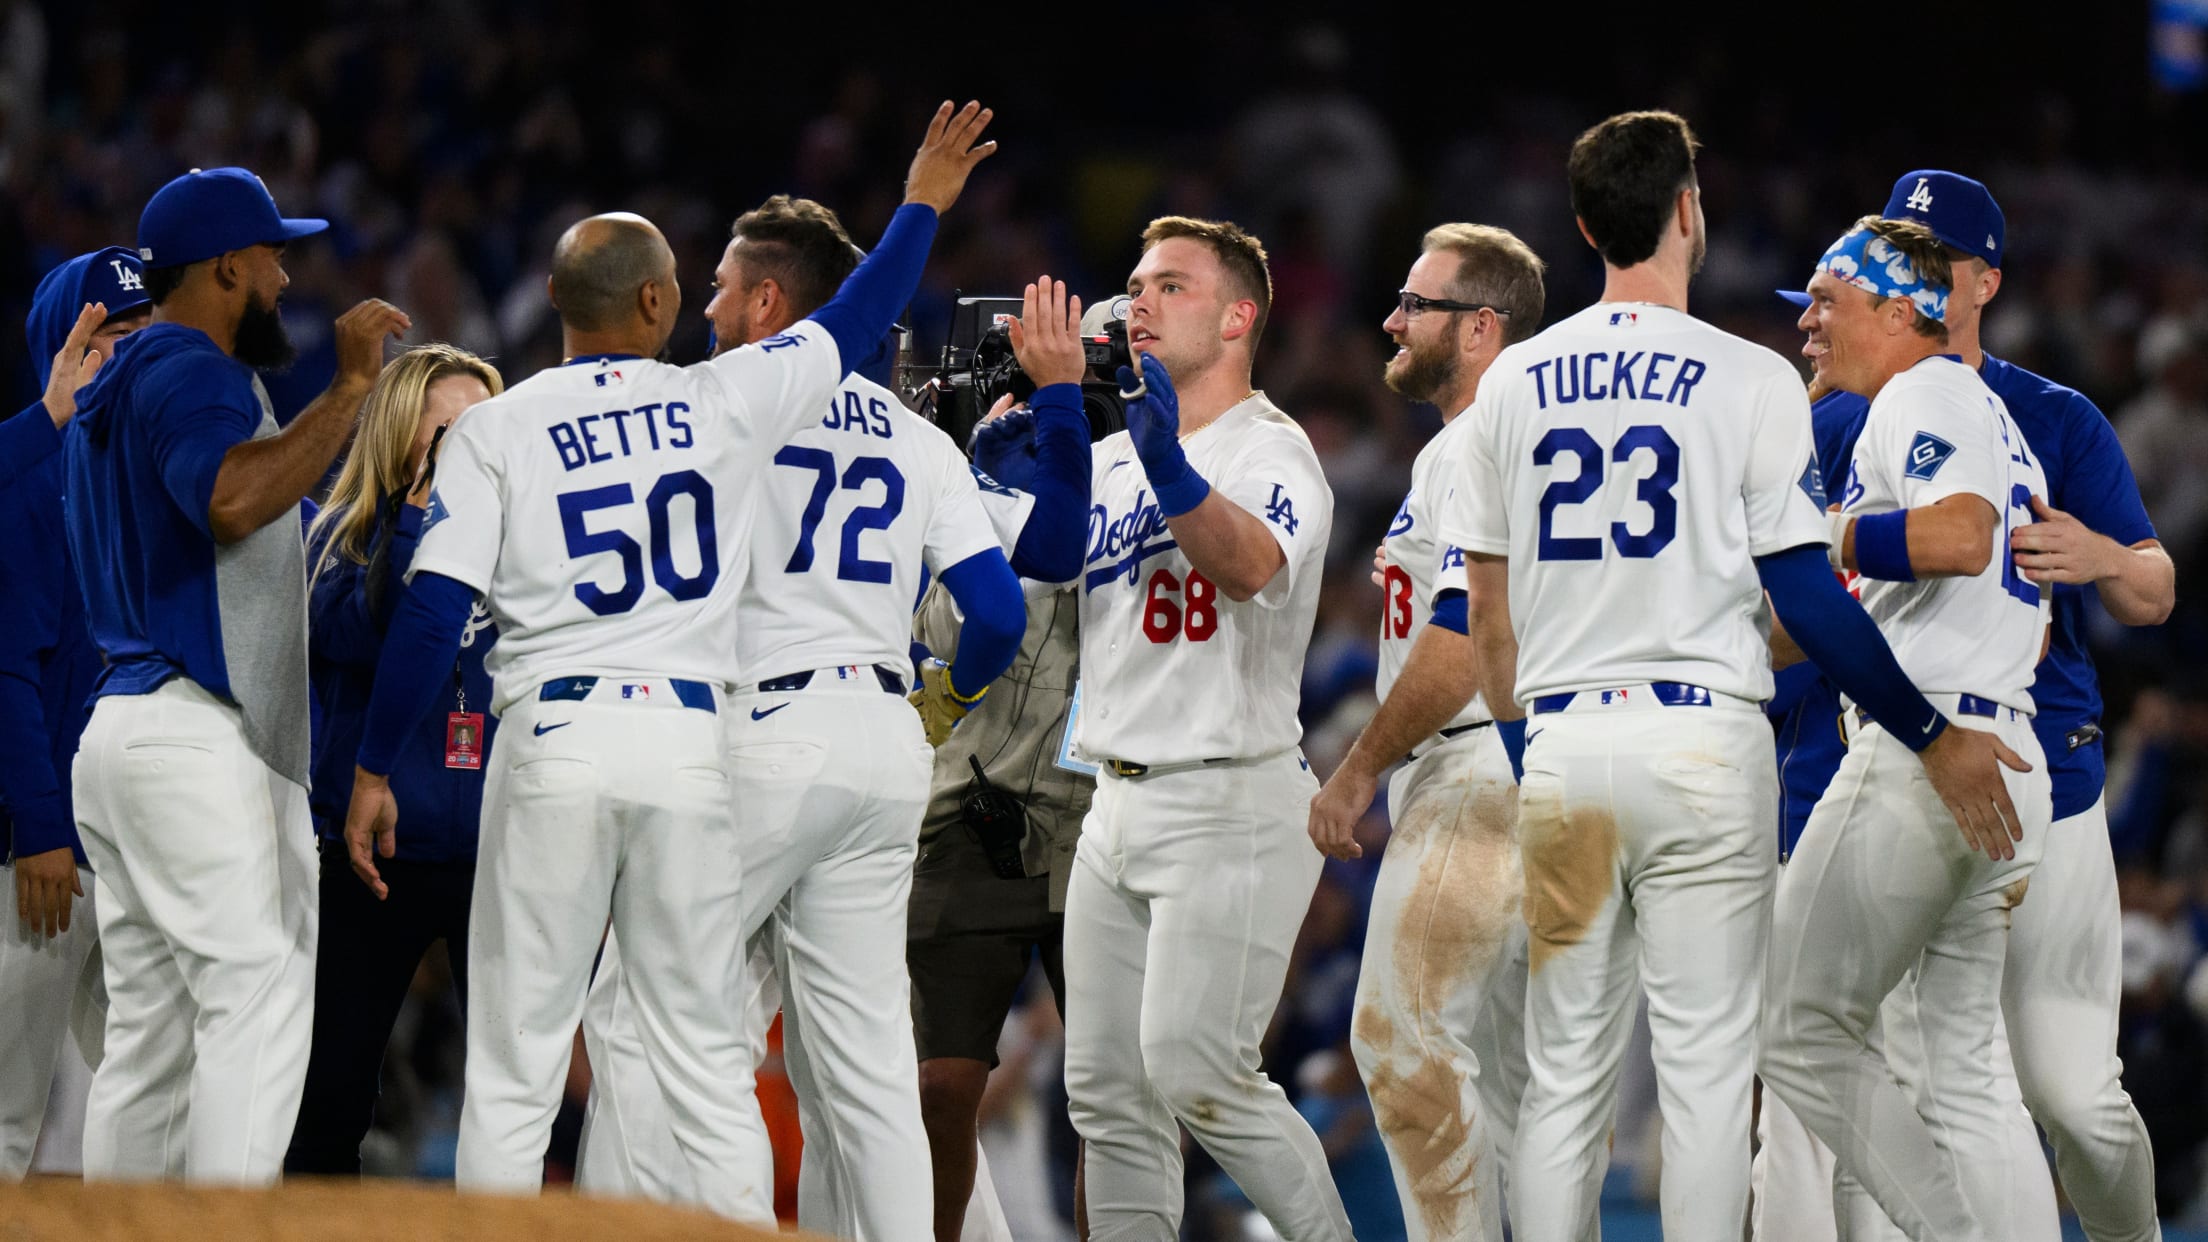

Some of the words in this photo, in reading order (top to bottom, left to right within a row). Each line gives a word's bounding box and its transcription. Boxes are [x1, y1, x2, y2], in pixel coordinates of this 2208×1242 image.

[1906, 178, 1933, 212] LA
[1526, 351, 1706, 409] TUCKER
[547, 401, 694, 472] BETTS
[774, 445, 905, 584] 72
[1264, 482, 1299, 537] LA
[1532, 425, 1680, 562] 23
[556, 469, 720, 616] 50
[1085, 489, 1169, 587] Dodge
[1142, 568, 1218, 643] 68
[1384, 564, 1413, 640] 13
